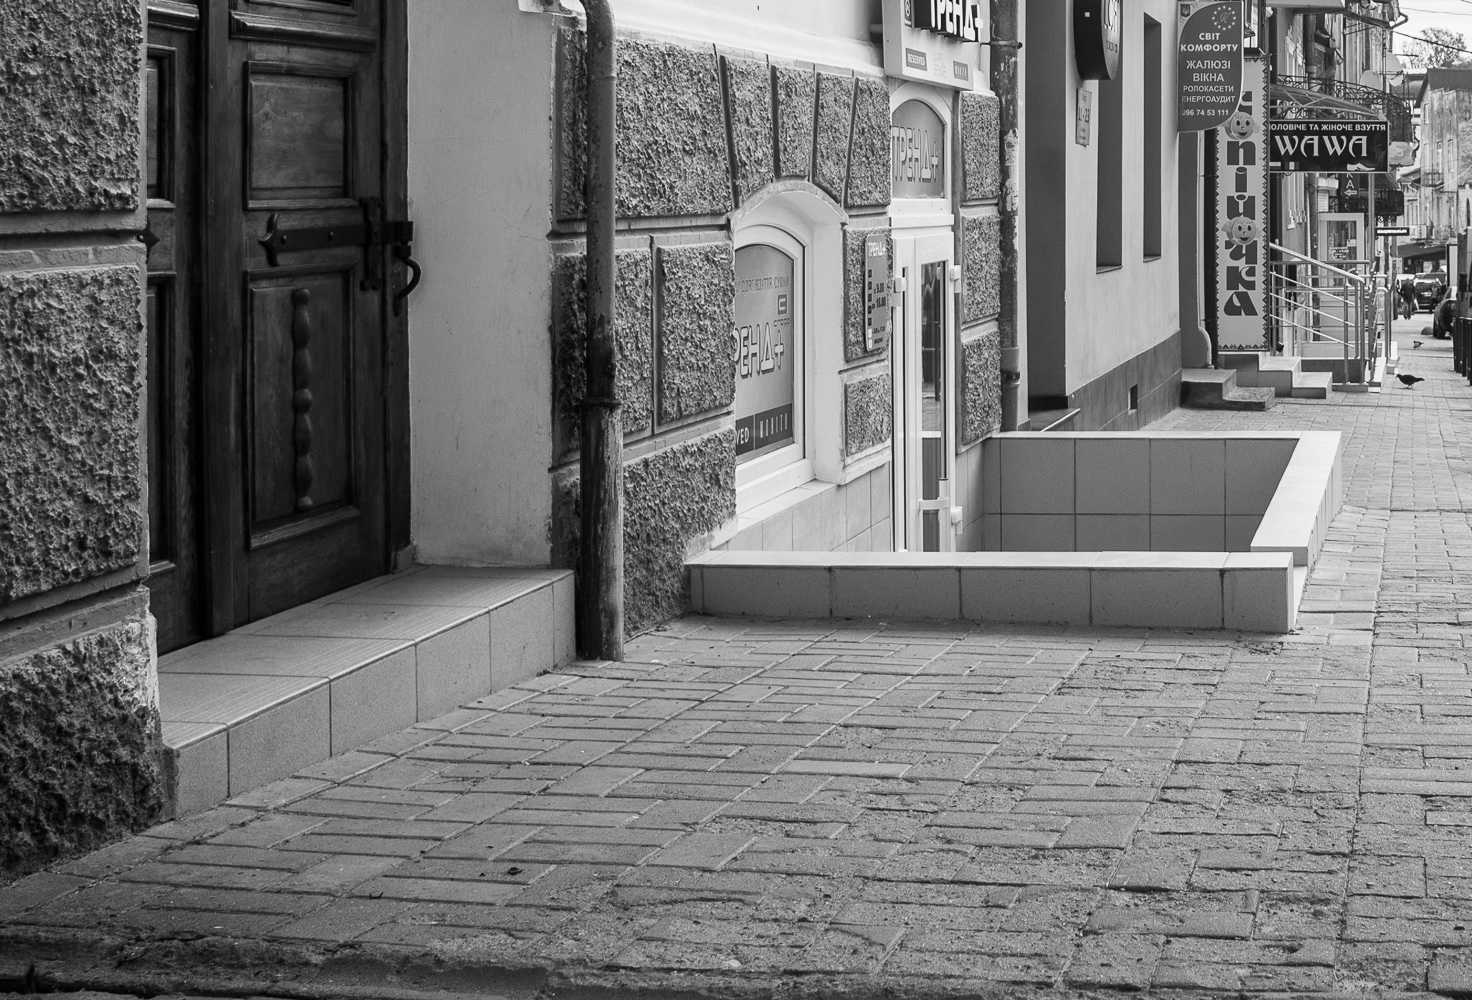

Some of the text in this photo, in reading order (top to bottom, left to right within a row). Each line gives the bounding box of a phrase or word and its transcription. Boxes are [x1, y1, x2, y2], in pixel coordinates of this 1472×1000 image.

[1198, 32, 1221, 41] СВІТ
[1180, 43, 1239, 52] КОМФОРТУ
[1186, 60, 1231, 70] ЖАЛЮЗІ
[1192, 73, 1225, 82] ВІКНА
[1270, 123, 1386, 131] ОЛОВІЧЕ ТА ЖІНОЧЕ ВЗУТТЯ
[1274, 135, 1368, 158] WAWA
